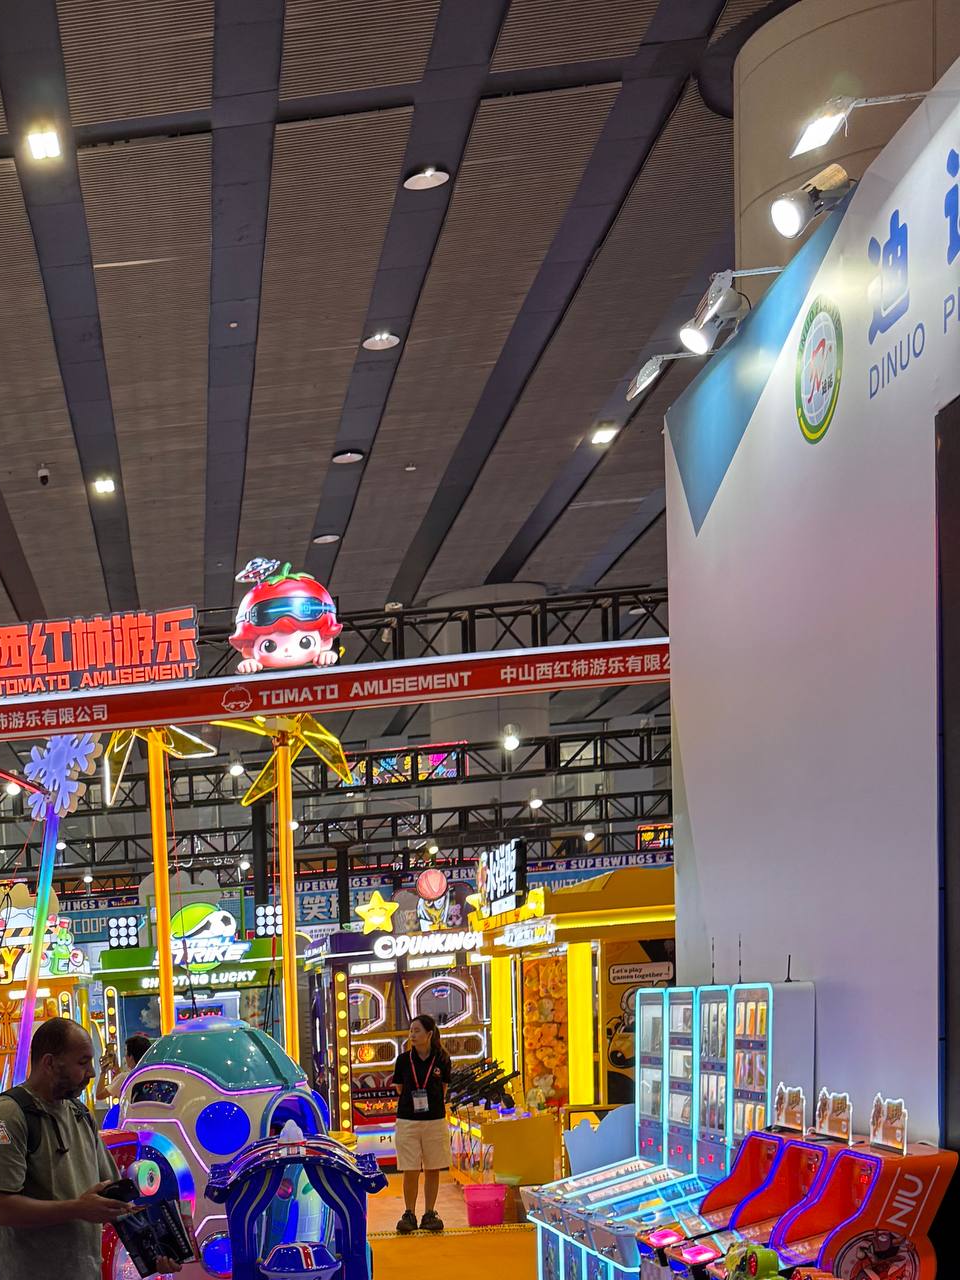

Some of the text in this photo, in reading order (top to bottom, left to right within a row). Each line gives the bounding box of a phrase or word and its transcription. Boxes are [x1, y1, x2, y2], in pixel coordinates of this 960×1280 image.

[868, 322, 926, 400] DINUO
[79, 662, 196, 689] AMUSEMENT
[258, 683, 339, 706] TOMATO
[349, 671, 472, 698] AMUSEMENT
[570, 853, 653, 869] SUPERWINGS
[141, 970, 257, 989] SHOTING LUCKY
[379, 1135, 392, 1143] P1
[886, 1174, 925, 1229] NIU
